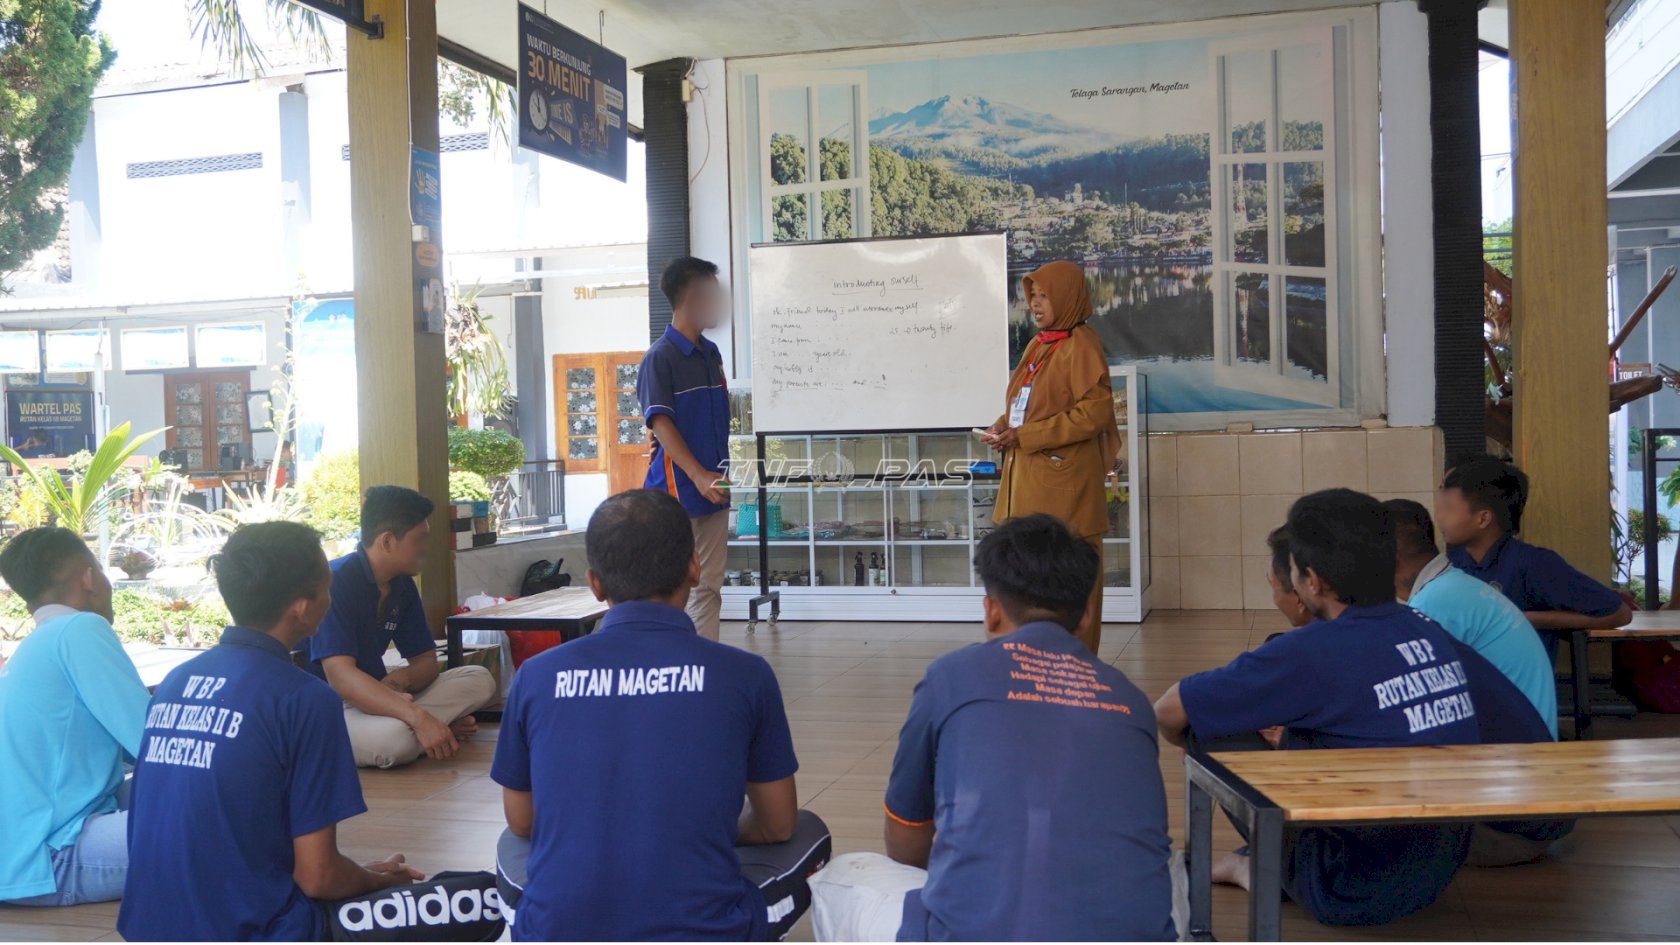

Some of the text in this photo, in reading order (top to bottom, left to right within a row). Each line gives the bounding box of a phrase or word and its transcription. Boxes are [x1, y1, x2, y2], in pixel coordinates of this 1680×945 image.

[526, 33, 592, 76] WAKTU BERKUNJUNG
[527, 50, 545, 81] 30
[548, 59, 591, 102] MENIT
[1070, 81, 1190, 100] Telaga Sarangan, Magetan
[19, 402, 82, 415] WARTEL PAS
[1017, 643, 1042, 657] Masa
[1395, 638, 1436, 666] WBP
[554, 664, 705, 699] RUTAN MAGETAN
[1020, 662, 1048, 674] Masa
[182, 675, 227, 700] WBP
[1007, 691, 1043, 702] Adalah
[1035, 682, 1097, 699] Masa depan
[1373, 671, 1428, 710] RUTAN
[1420, 663, 1460, 694] KELAS
[176, 704, 217, 733] KELAS
[225, 711, 244, 739] B
[145, 735, 216, 770] MAGETAN
[338, 885, 502, 932] adidas
